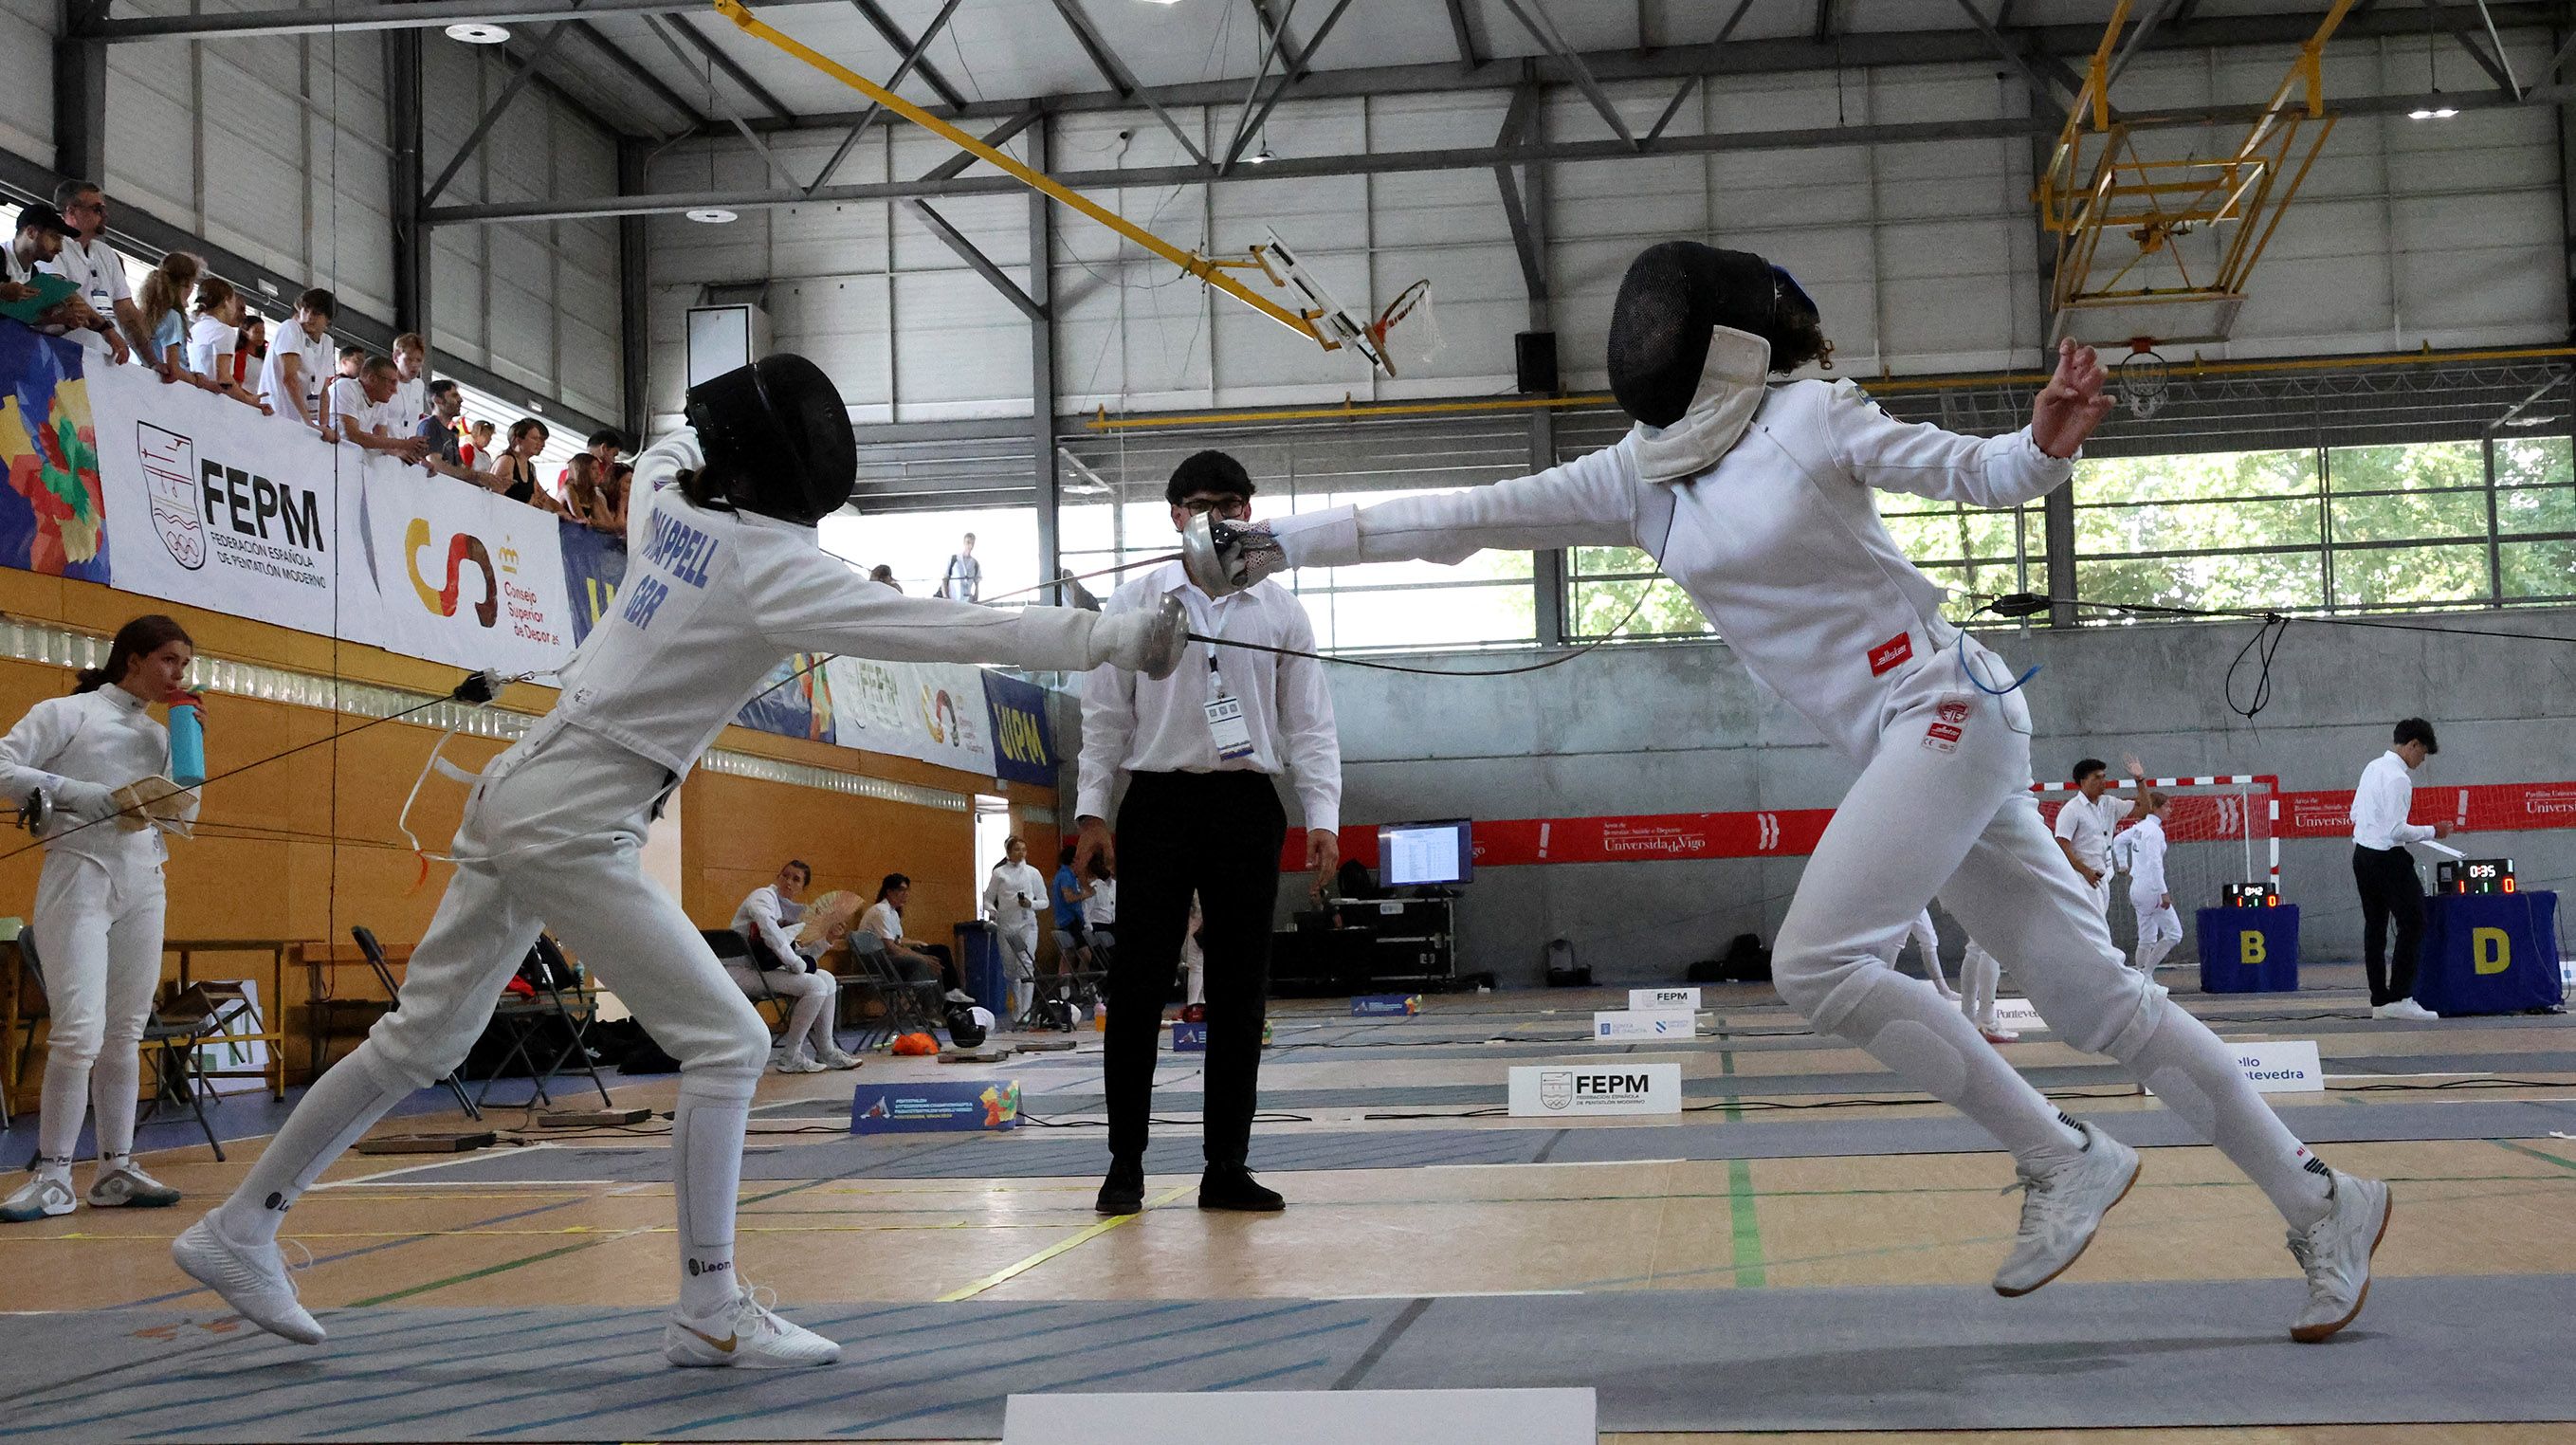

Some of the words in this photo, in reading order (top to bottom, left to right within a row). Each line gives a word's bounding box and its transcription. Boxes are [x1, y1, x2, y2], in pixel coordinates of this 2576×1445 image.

[201, 459, 324, 552] FEPM
[210, 532, 267, 558] FEDERACIÓN
[267, 546, 315, 568] ESPAÑOLA
[217, 551, 232, 565] DE
[231, 555, 282, 578] PENTATLÓN
[282, 568, 326, 589] MODERNO
[504, 581, 537, 606] Consejo
[623, 575, 668, 631] GBR
[507, 601, 543, 622] Superior
[523, 624, 560, 646] Depores
[992, 703, 1047, 766] UIPM
[2470, 865, 2496, 878] 0:35
[2504, 878, 2514, 893] 0
[2240, 930, 2267, 964] B
[2473, 926, 2511, 975] D
[1657, 992, 1688, 1001] FEPM
[1577, 1074, 1649, 1094] FEPM
